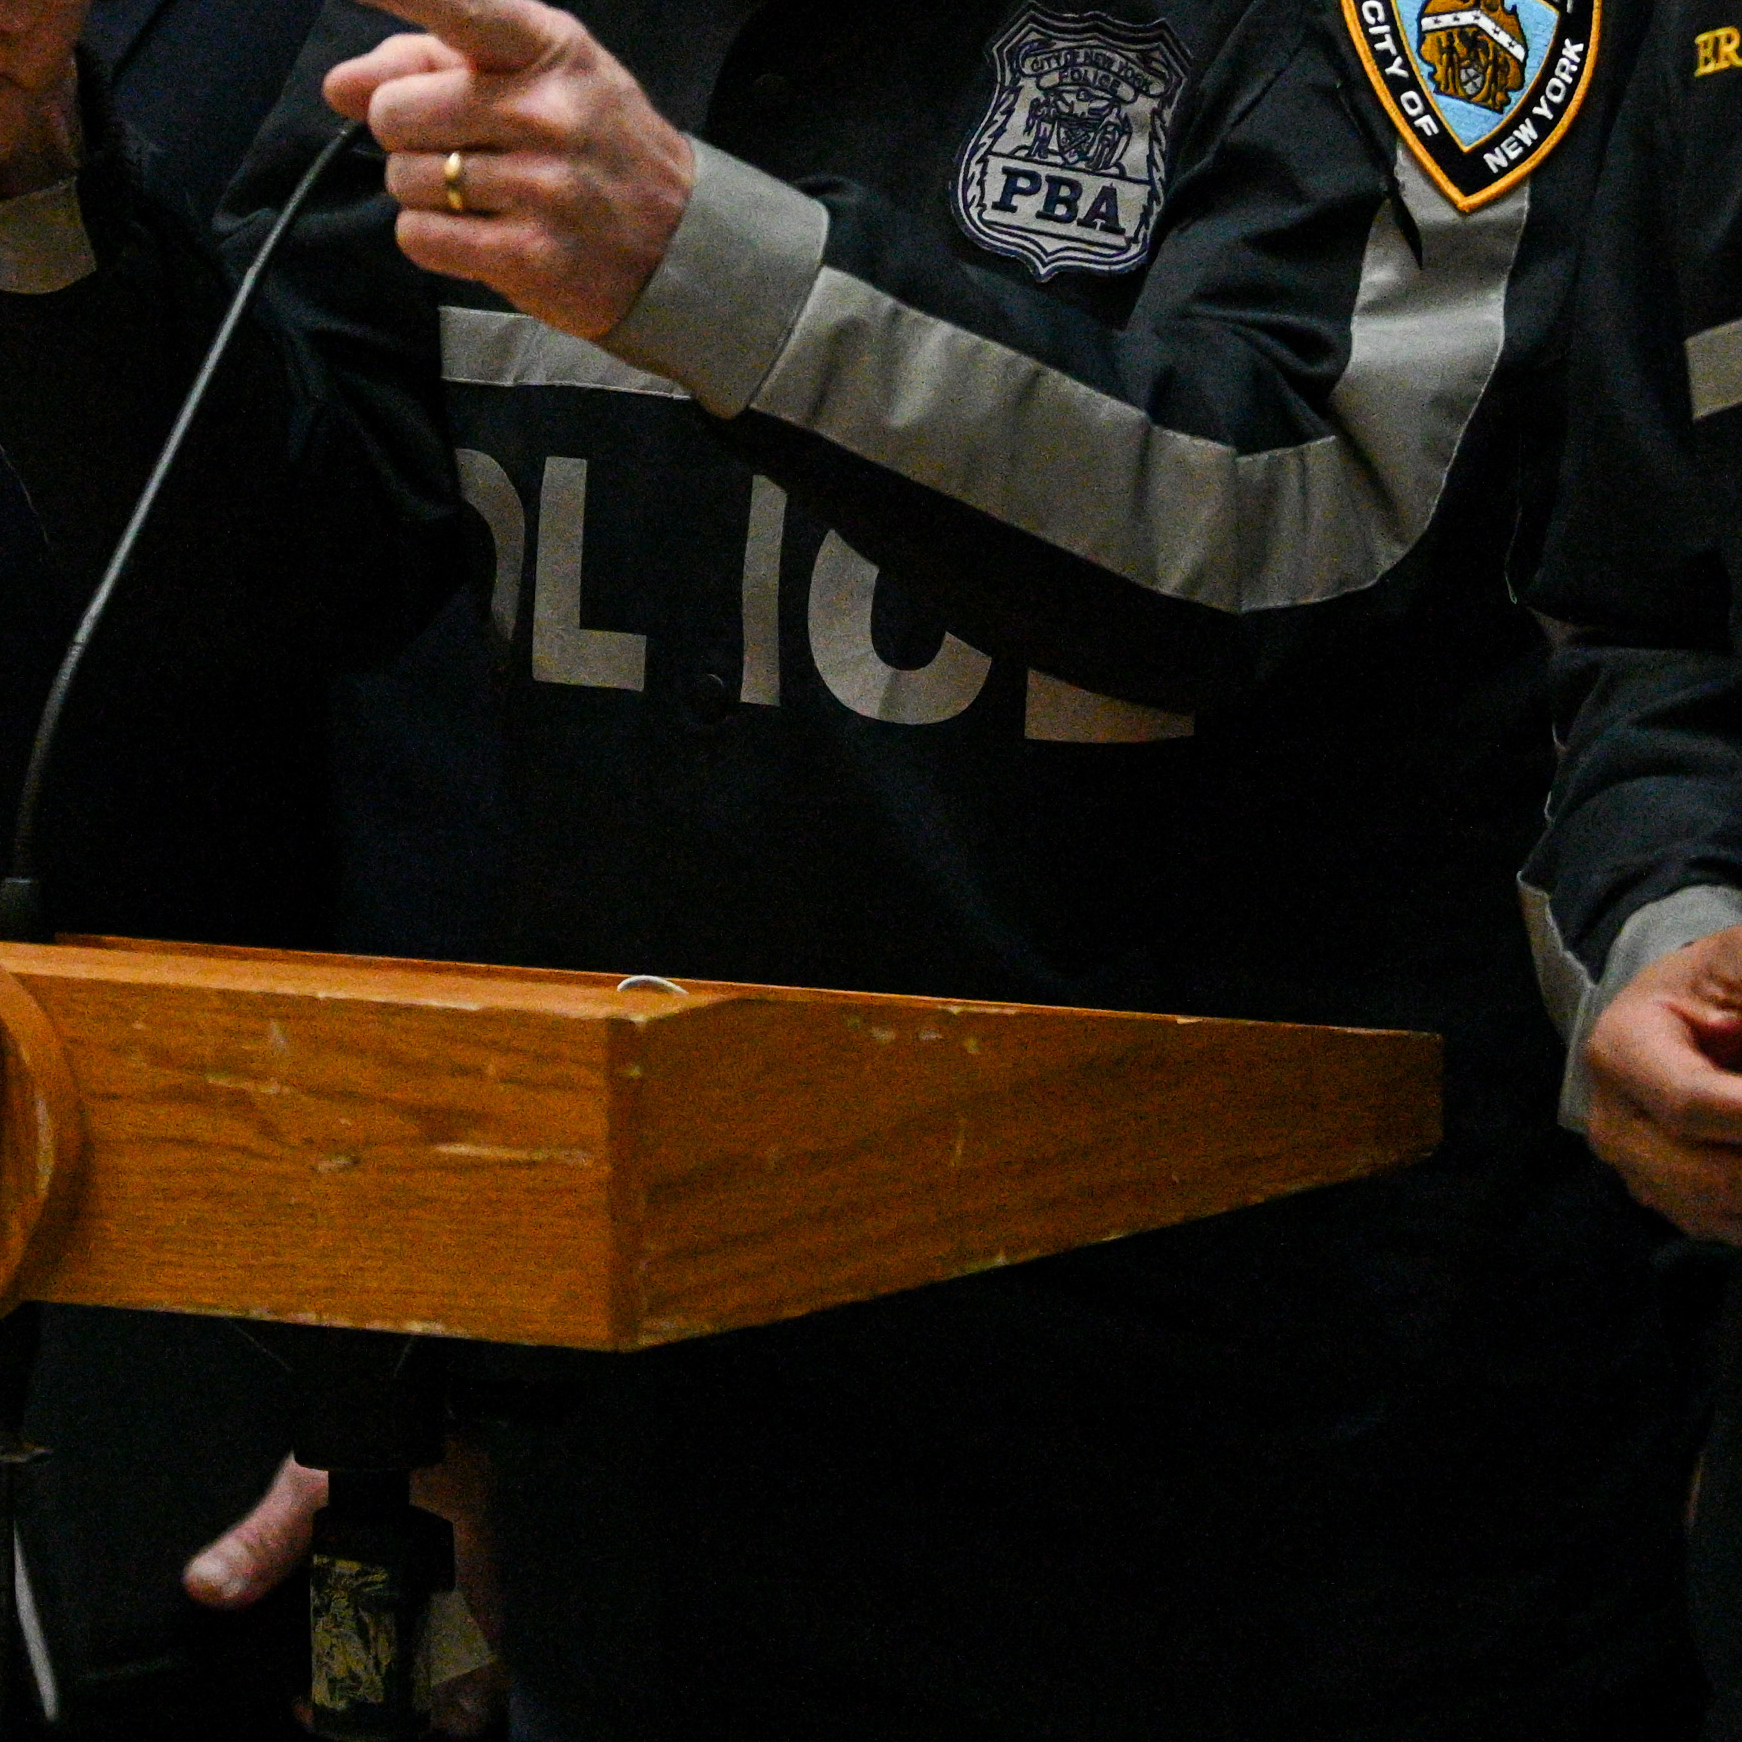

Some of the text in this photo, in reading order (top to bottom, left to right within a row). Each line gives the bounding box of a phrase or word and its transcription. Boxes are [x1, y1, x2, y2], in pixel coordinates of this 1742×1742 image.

[1058, 68, 1121, 97] POLICE
[1360, 0, 1441, 139] CITY OF
[1482, 38, 1585, 174] NEW YORK
[991, 164, 1126, 234] PBA
